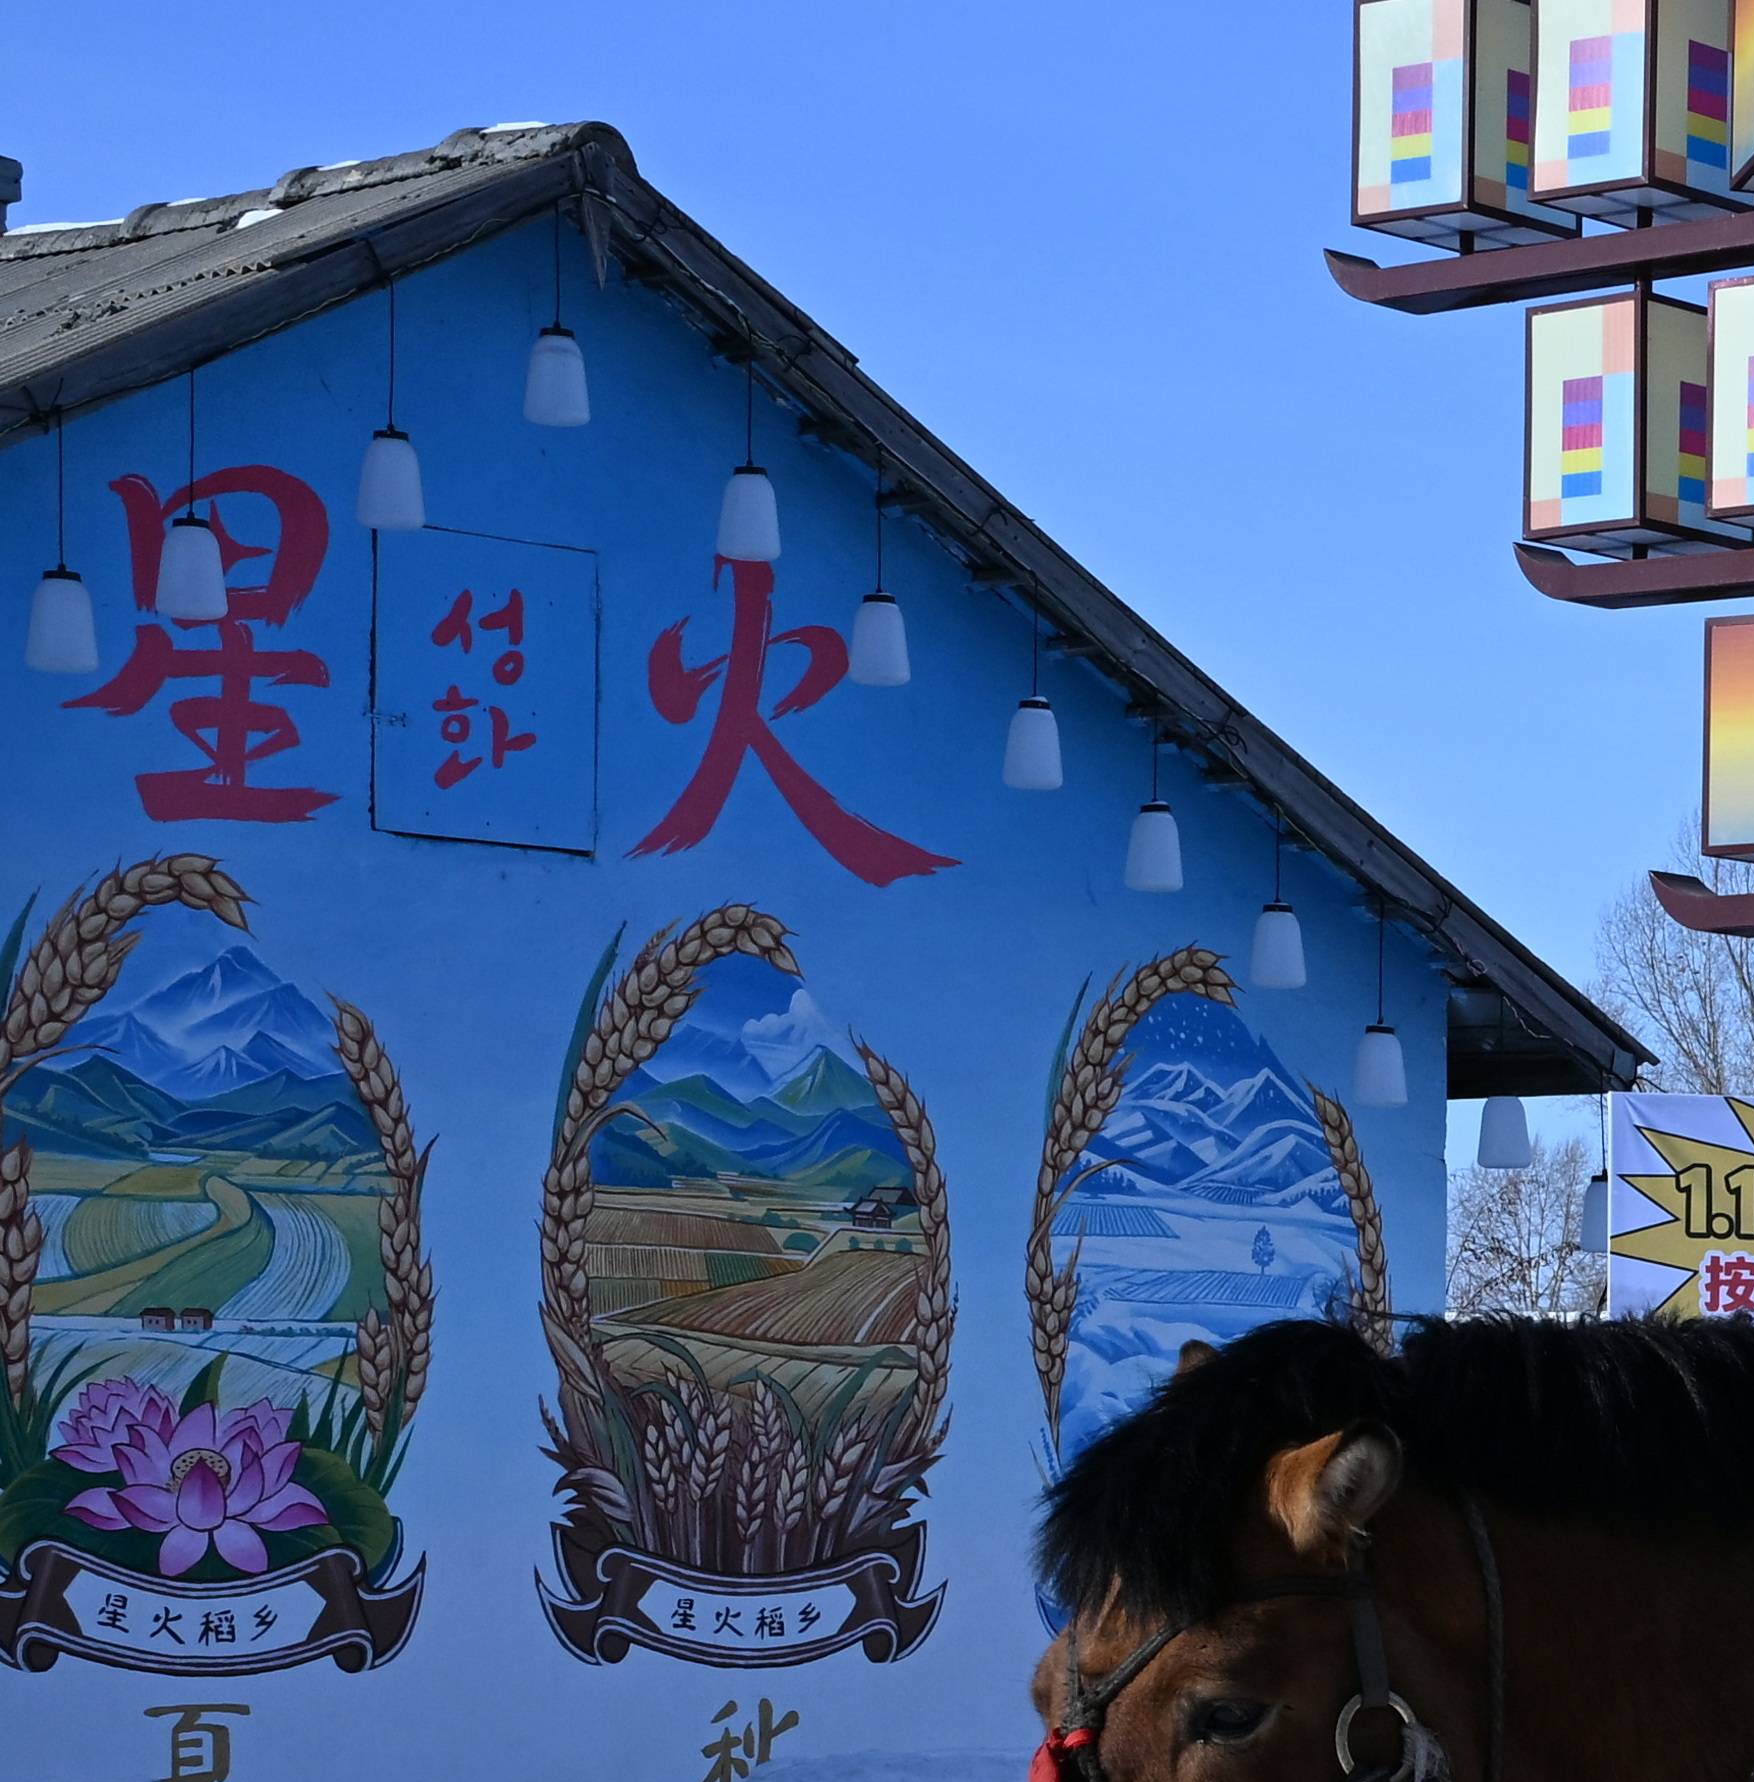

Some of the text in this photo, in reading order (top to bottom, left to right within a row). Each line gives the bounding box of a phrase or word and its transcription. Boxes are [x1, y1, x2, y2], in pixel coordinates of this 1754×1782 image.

[60, 464, 962, 888] 星 火
[432, 588, 538, 789] 성화
[97, 1592, 278, 1646] 星火稻乡
[671, 1598, 821, 1640] 星火稻乡
